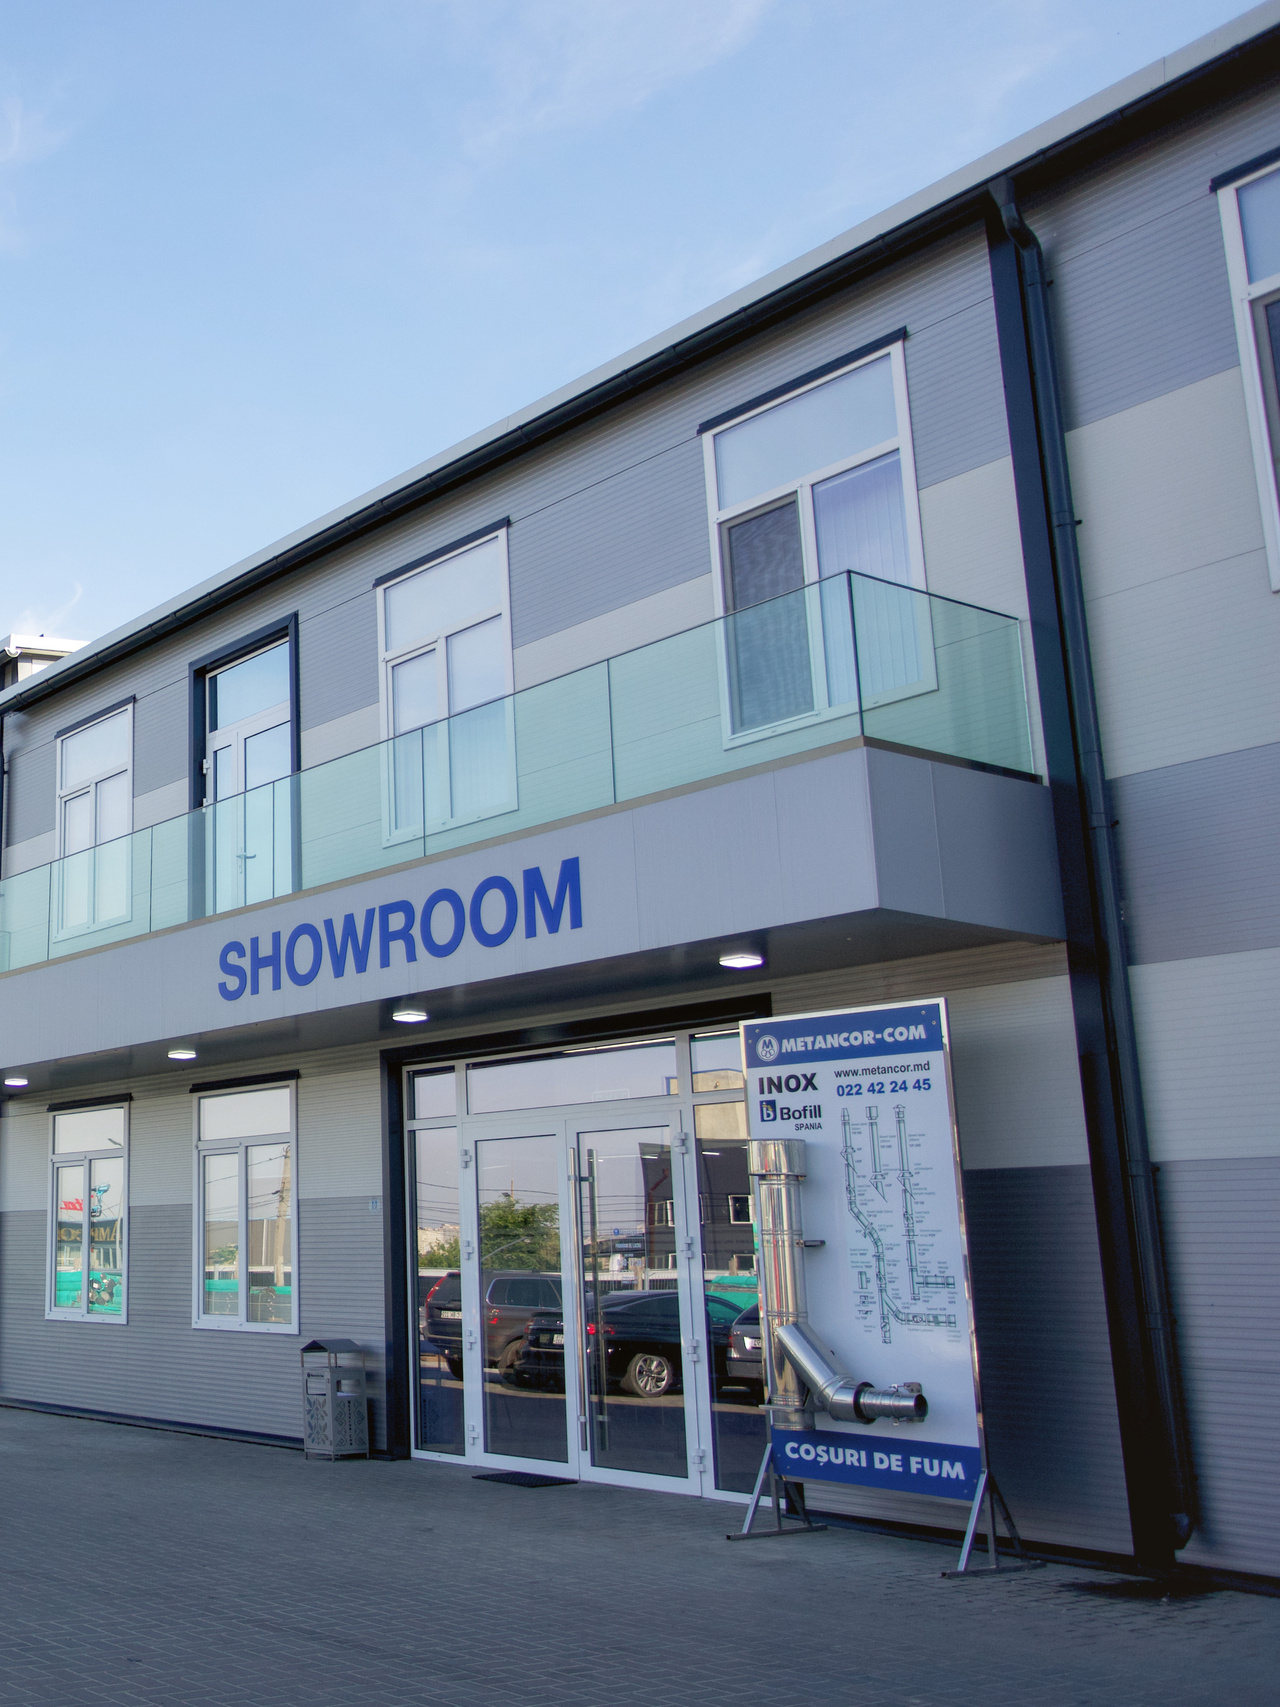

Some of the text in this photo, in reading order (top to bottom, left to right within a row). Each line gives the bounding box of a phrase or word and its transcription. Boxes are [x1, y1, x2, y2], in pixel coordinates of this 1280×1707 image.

[218, 856, 583, 1001] SHOWROOM
[781, 1024, 927, 1053] METANCOR-COM
[834, 1061, 931, 1078] www.metancor.md
[758, 1072, 818, 1095] INOX
[836, 1078, 931, 1097] 022 42 24 45
[779, 1105, 822, 1121] Bofill
[794, 1123, 823, 1132] SPANIA
[785, 1441, 966, 1480] COȘURI DE FUM
